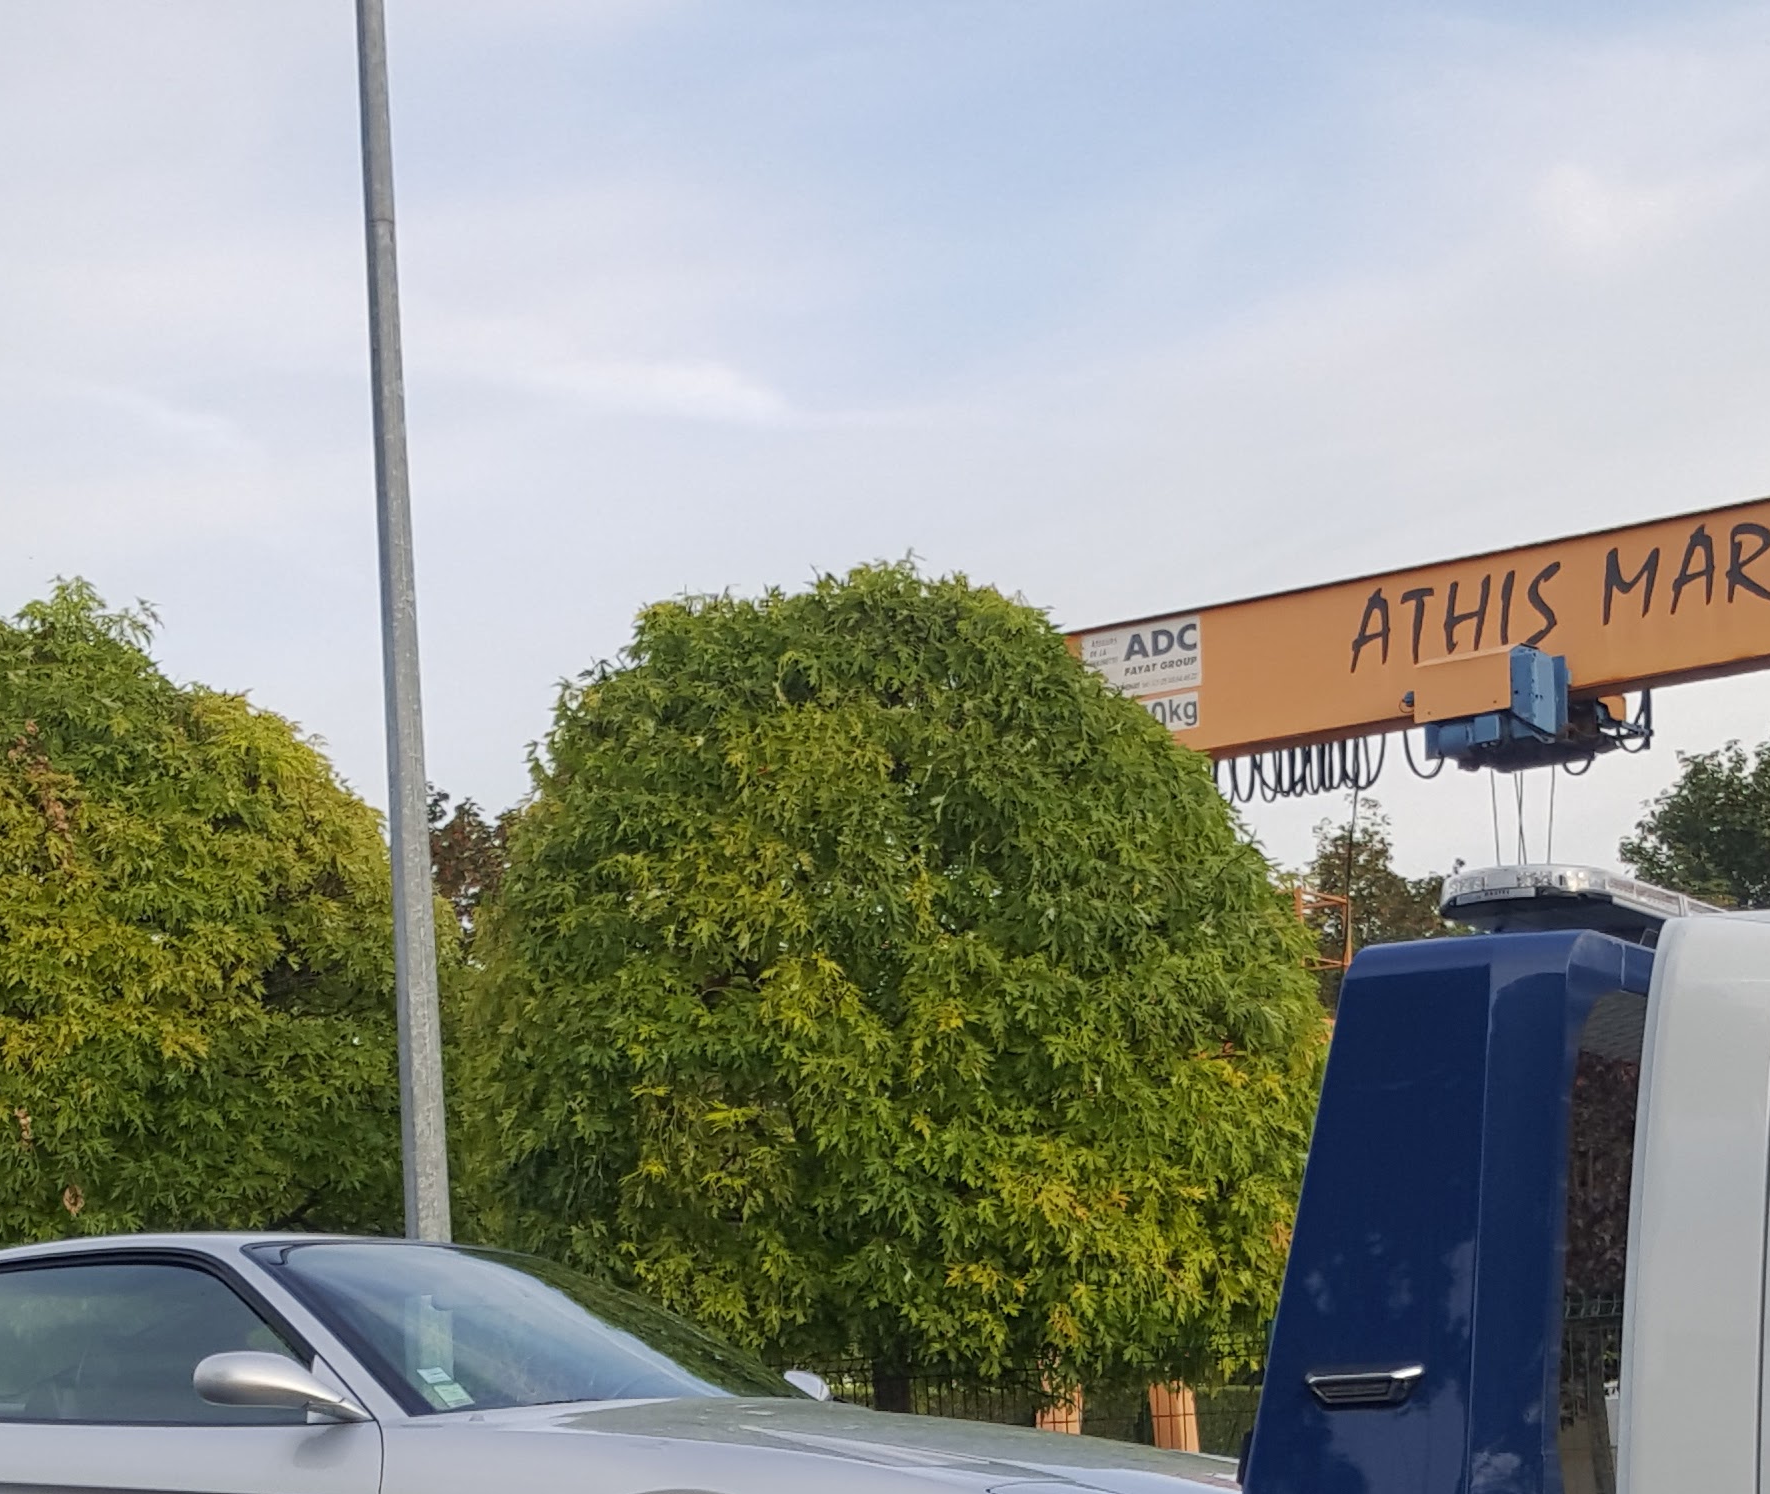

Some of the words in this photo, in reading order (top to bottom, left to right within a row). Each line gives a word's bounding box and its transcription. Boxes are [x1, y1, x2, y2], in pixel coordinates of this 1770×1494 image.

[1349, 560, 1558, 674] ATHIS
[1122, 623, 1197, 662] ADC
[1124, 662, 1158, 677] FAYAT
[1160, 656, 1197, 671] GROUP
[1146, 698, 1198, 726] 0kg
